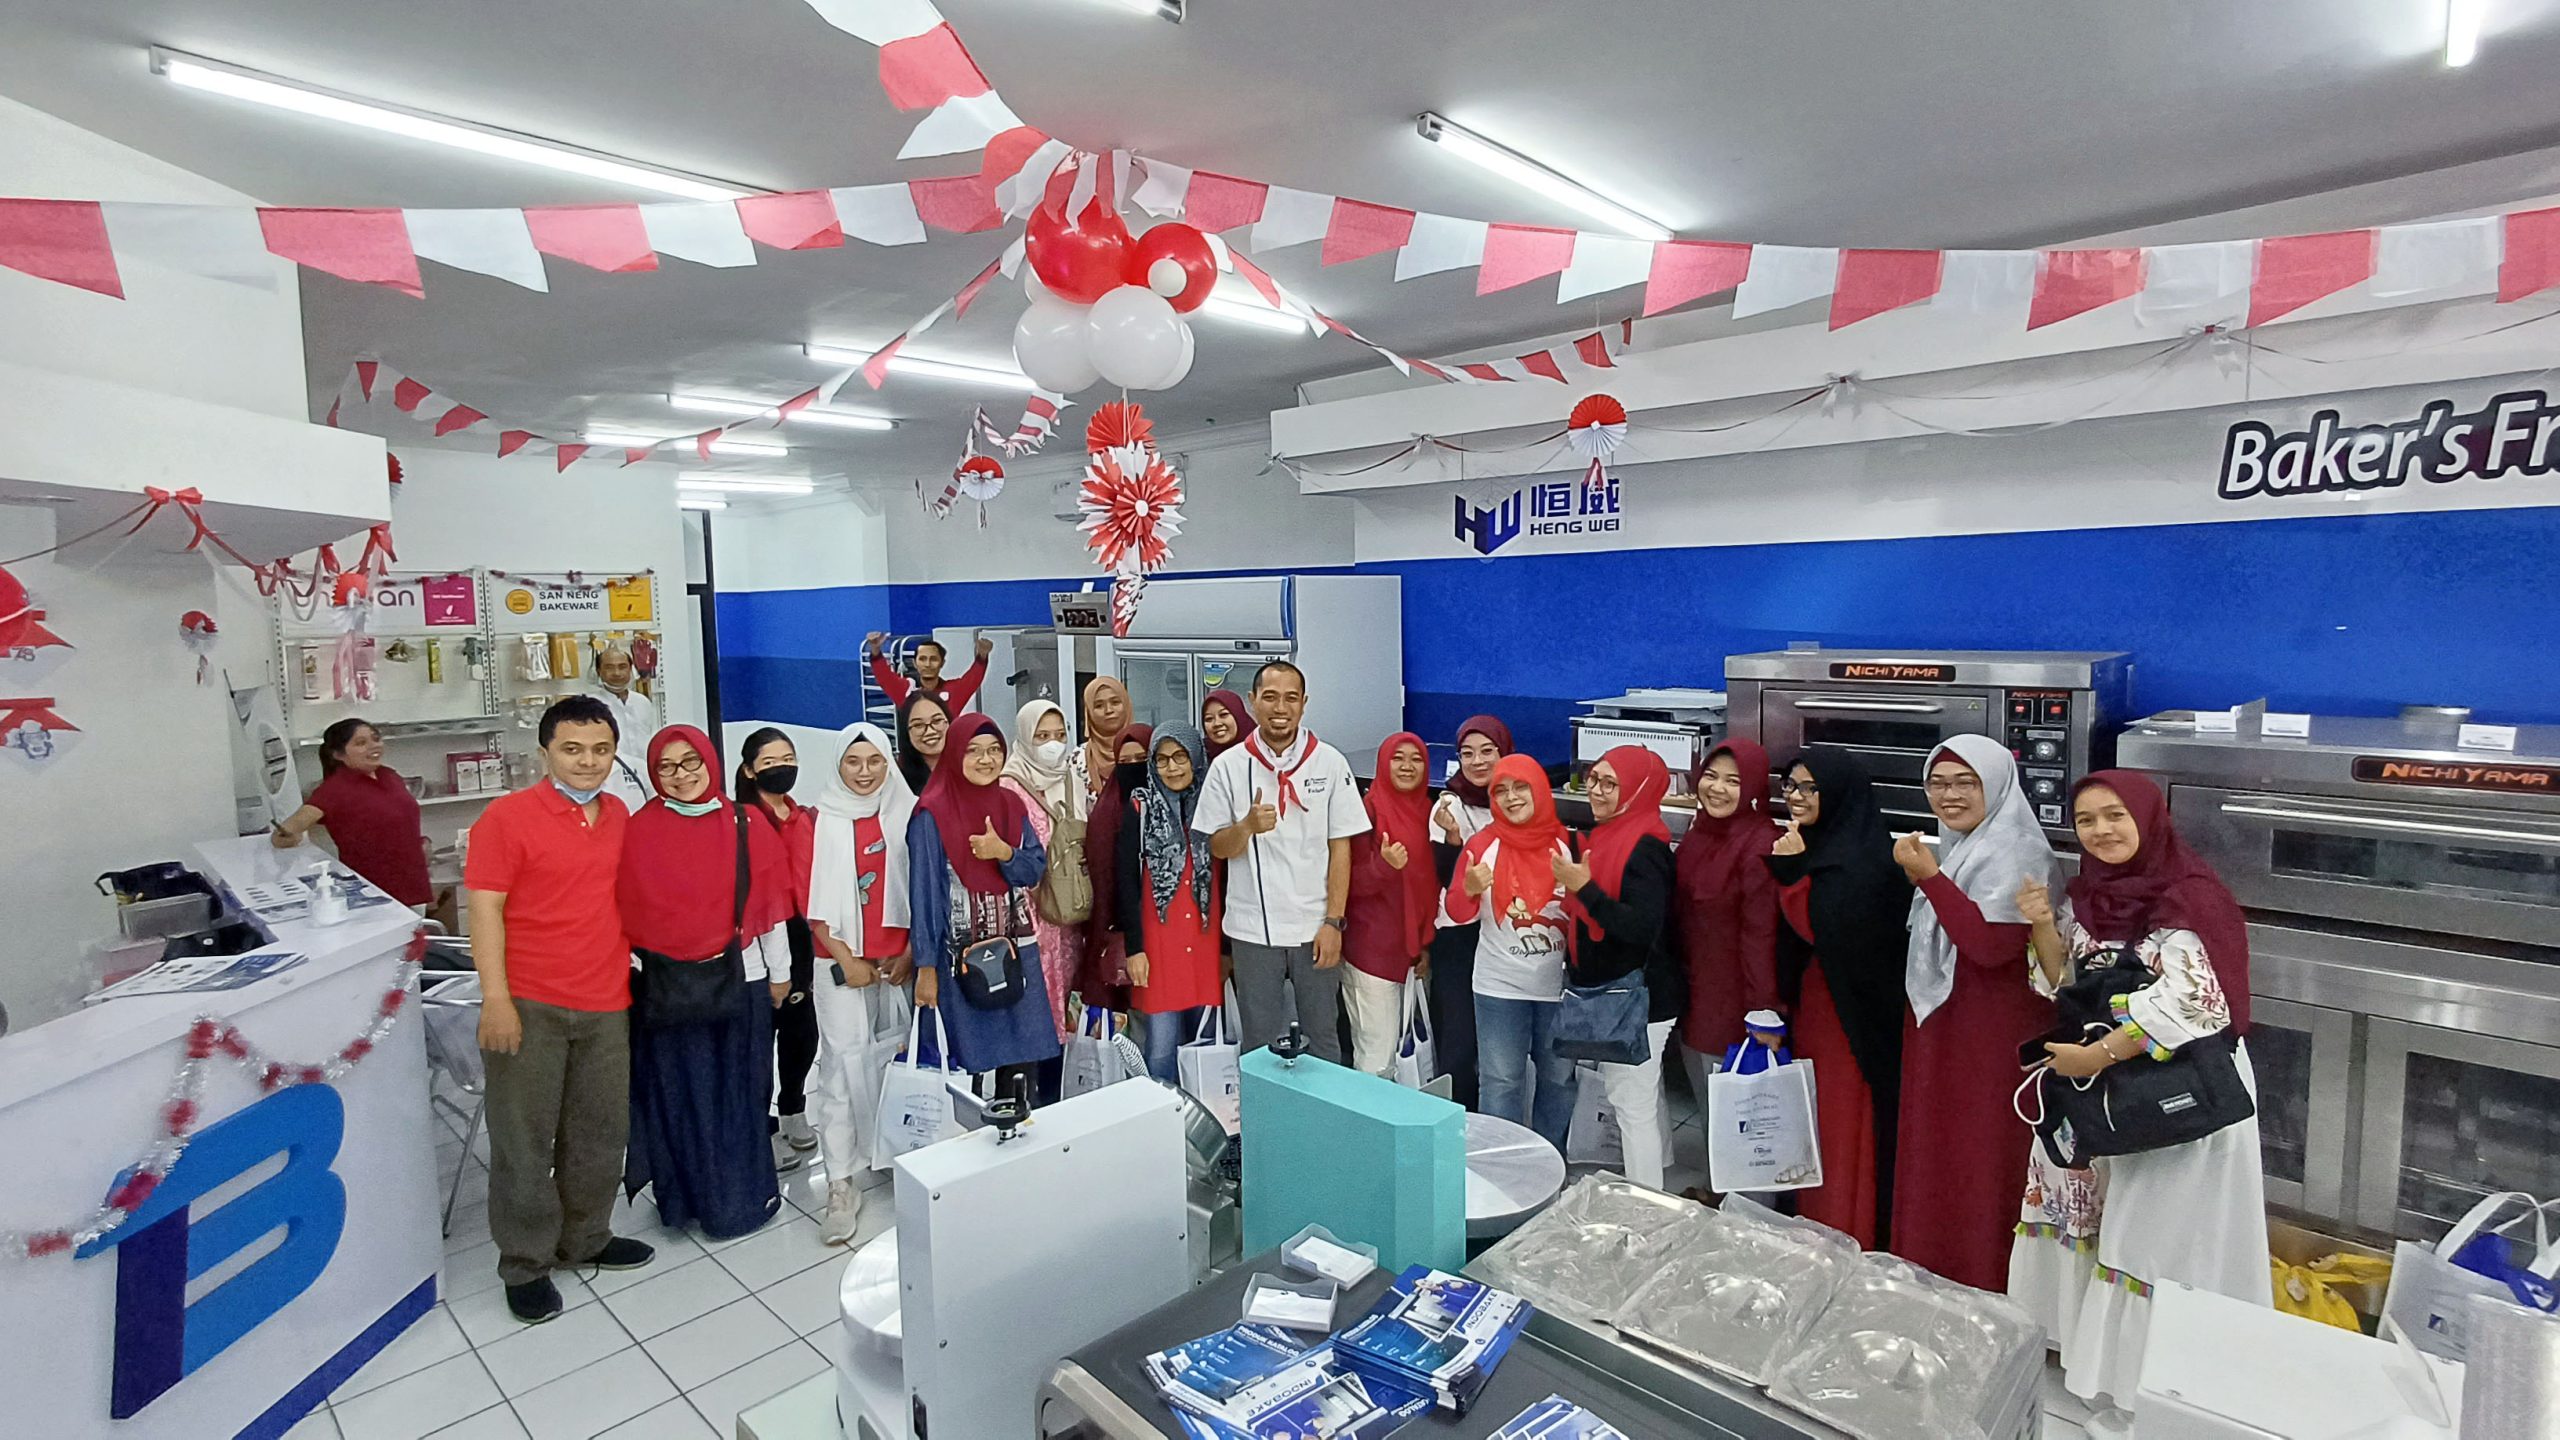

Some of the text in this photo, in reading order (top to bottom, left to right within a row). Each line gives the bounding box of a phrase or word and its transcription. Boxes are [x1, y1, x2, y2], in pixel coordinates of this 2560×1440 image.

[2226, 408, 2473, 492] Baker's
[1530, 518, 1620, 535] HENG WEI
[539, 591, 599, 600] SAN NENG
[540, 602, 600, 612] BAKEWARE
[1465, 1291, 1498, 1330] INDOBAKE
[1246, 1378, 1312, 1417] INDOBAKE
